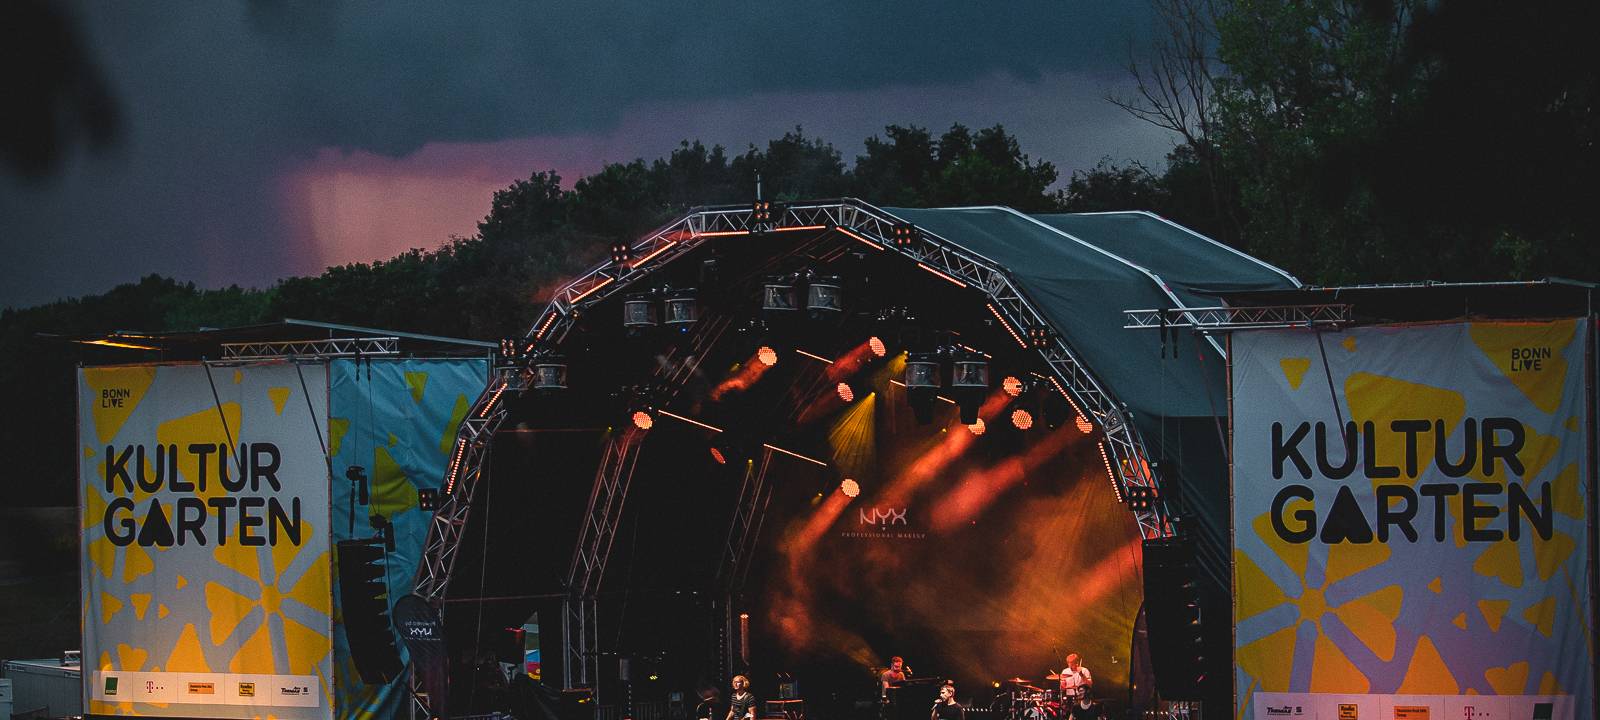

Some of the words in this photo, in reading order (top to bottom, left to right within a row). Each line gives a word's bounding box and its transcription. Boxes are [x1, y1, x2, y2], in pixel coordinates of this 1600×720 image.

[1511, 347, 1551, 360] BONN
[1511, 358, 1542, 372] LIVE
[102, 388, 130, 399] BONN
[102, 398, 124, 408] LIVE
[1271, 417, 1526, 480] KULTUR
[105, 442, 281, 494] KULTUR
[104, 496, 301, 547] GARTEN
[860, 507, 907, 525] NYX
[1270, 481, 1553, 545] GARTEN
